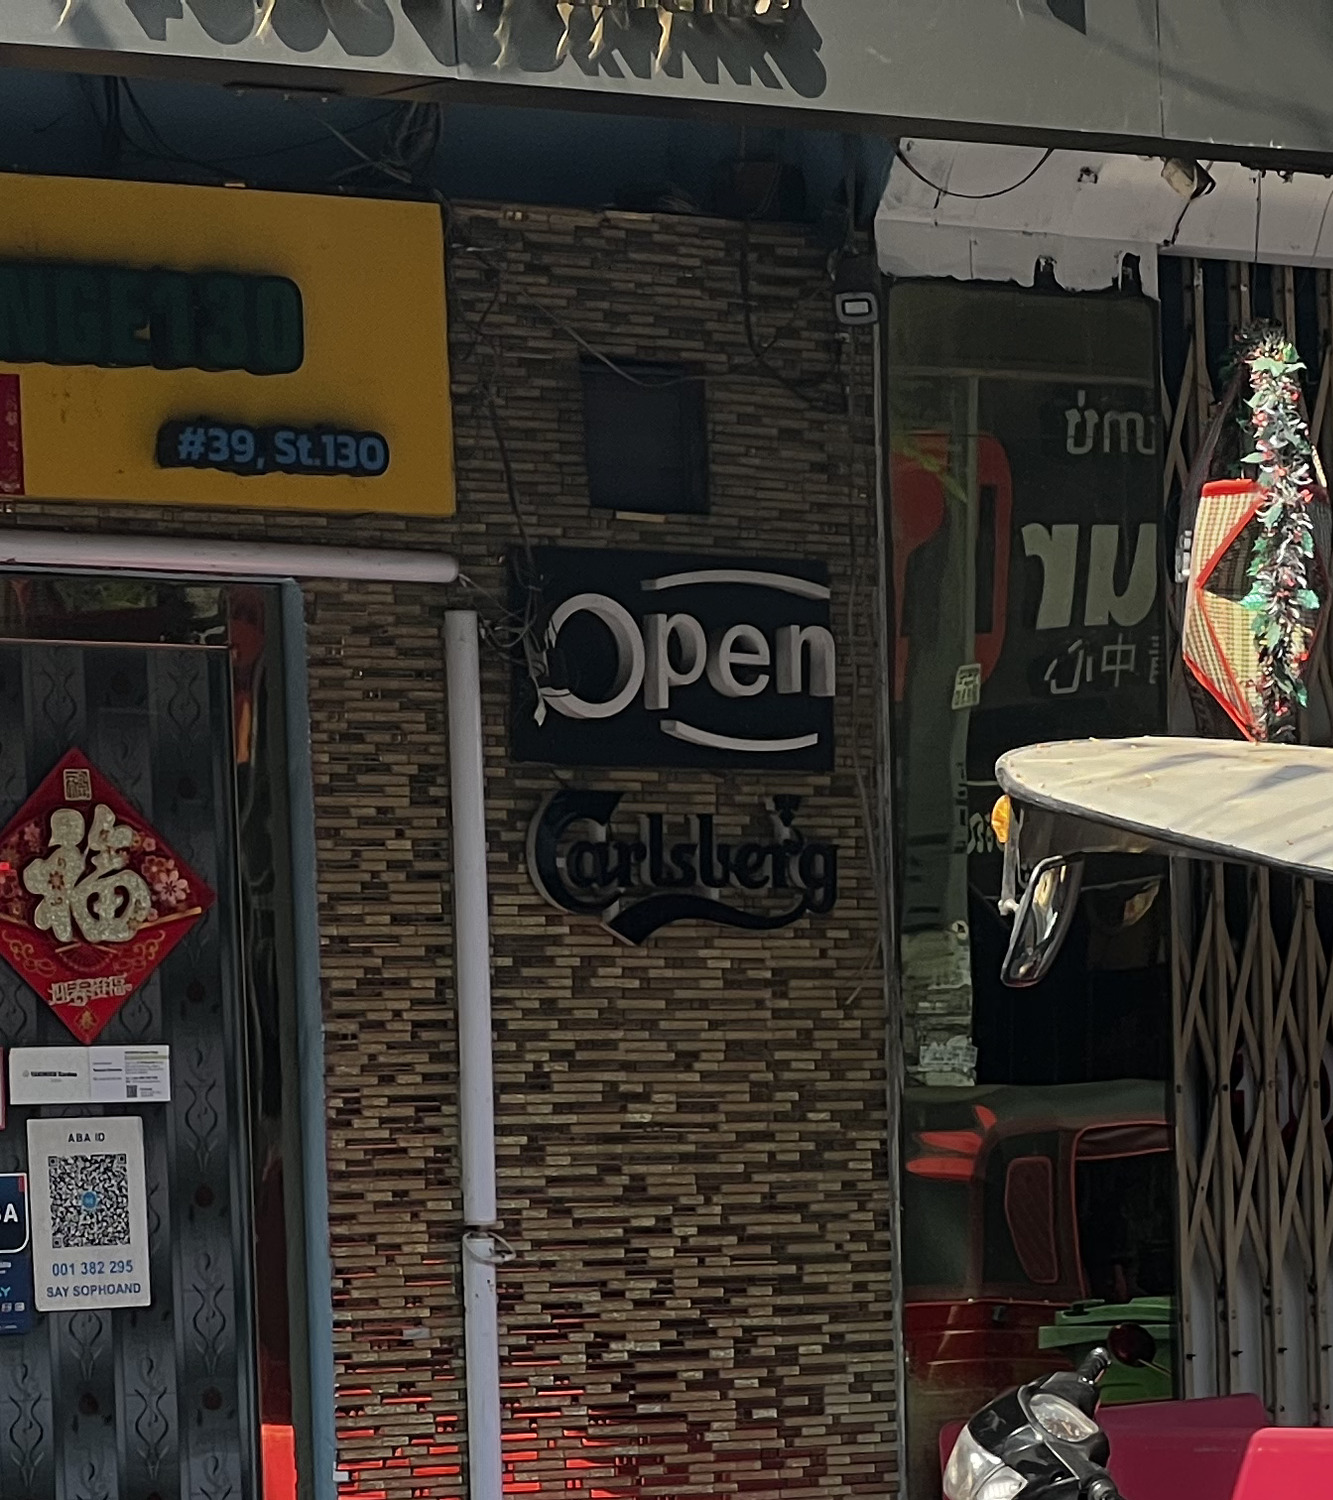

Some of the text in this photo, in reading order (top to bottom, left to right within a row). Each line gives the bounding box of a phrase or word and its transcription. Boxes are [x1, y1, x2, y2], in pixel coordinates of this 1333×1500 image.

[177, 427, 386, 471] #39, St.130
[534, 592, 836, 728] Open
[23, 803, 153, 943] 福
[528, 790, 837, 920] Carlsberg
[68, 1132, 105, 1143] ABA ID
[52, 1259, 133, 1276] 001 382 295
[47, 1285, 69, 1297] SAY
